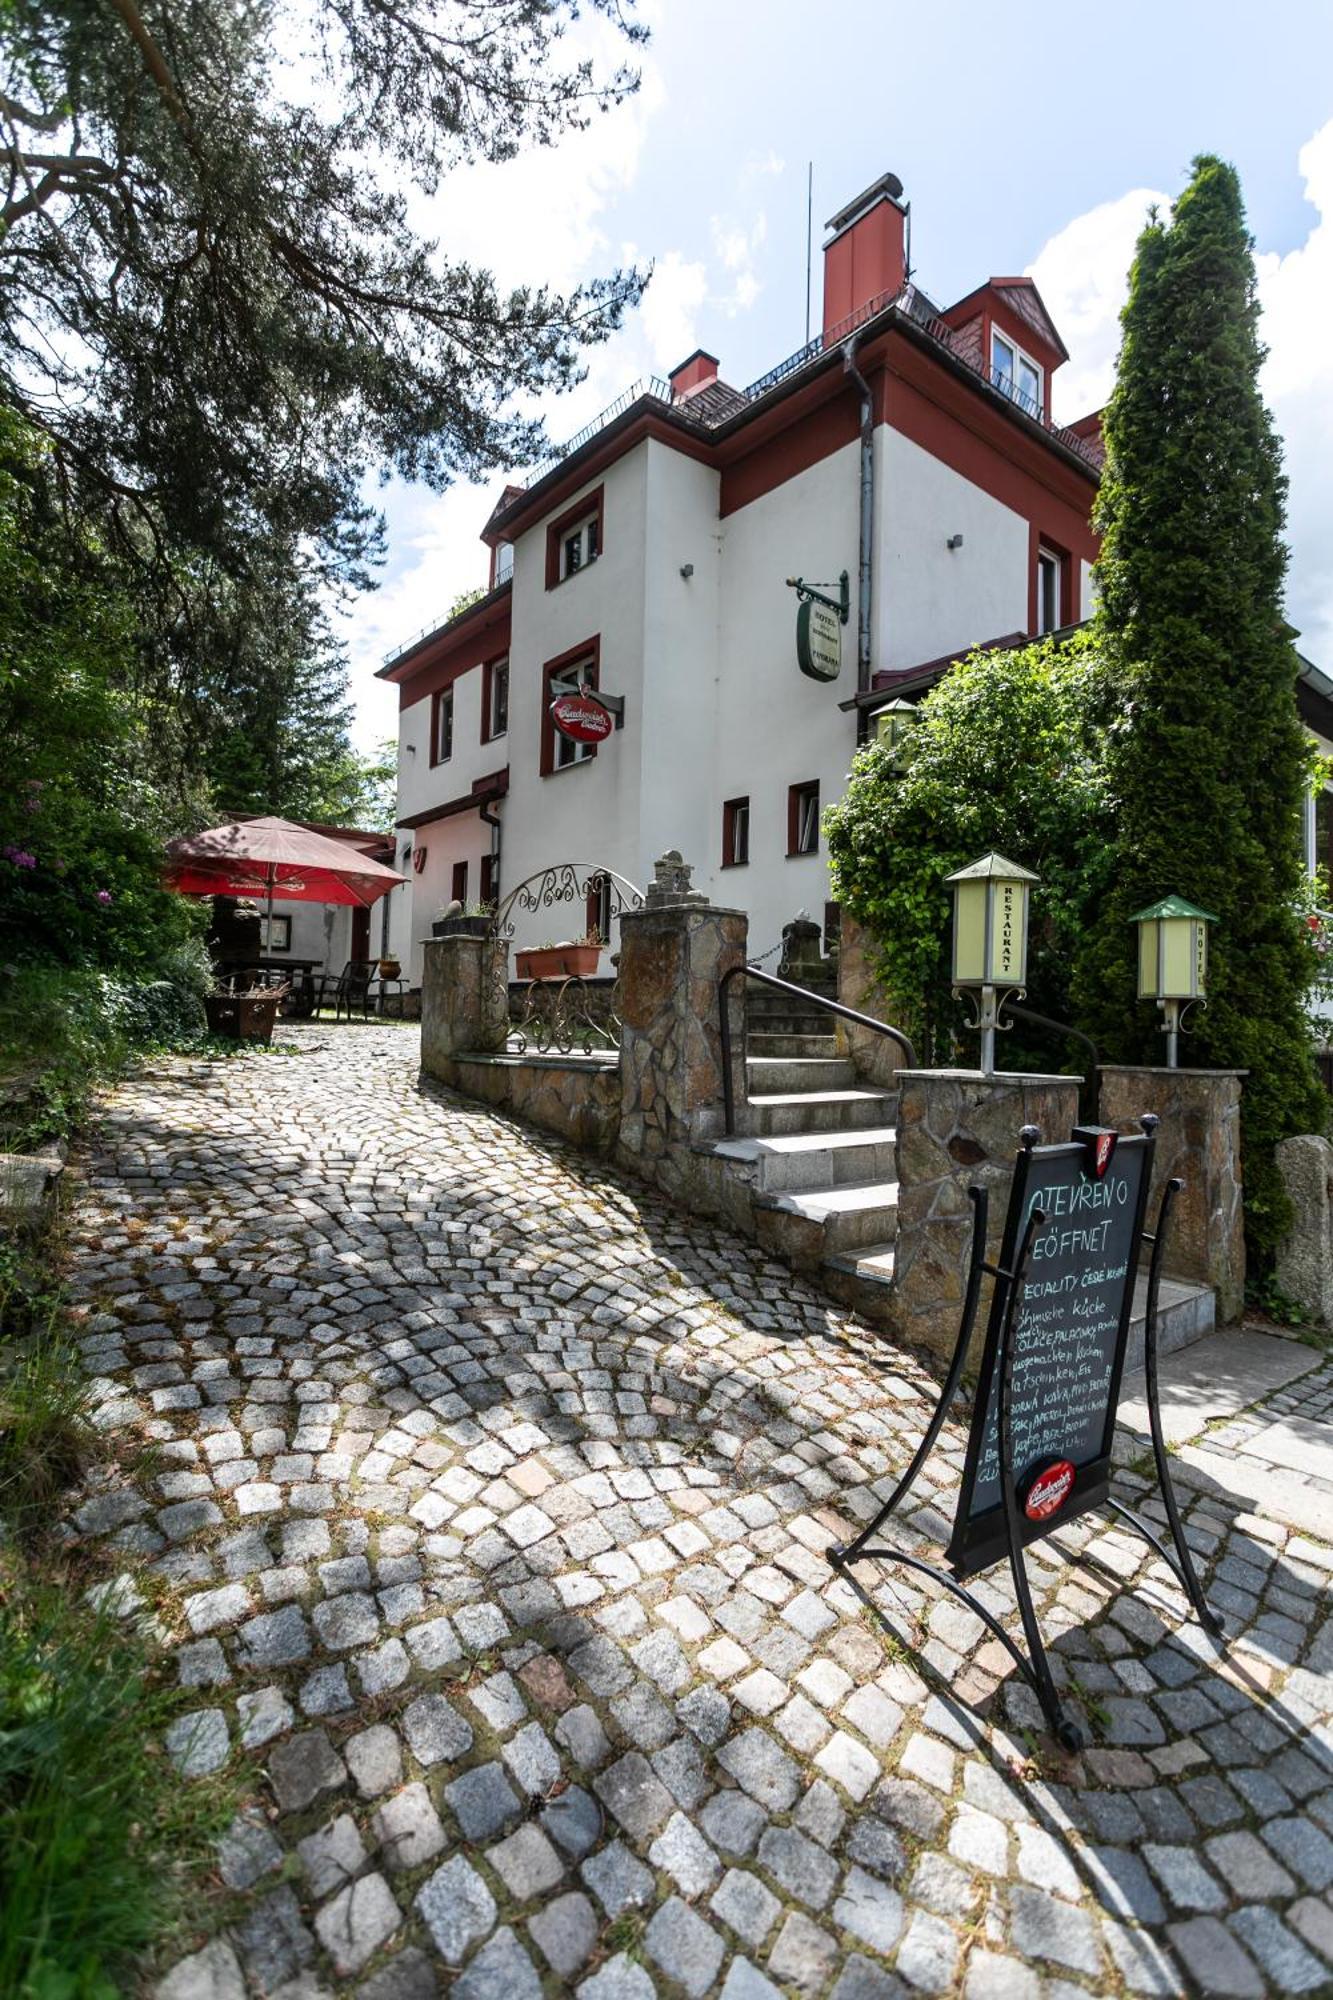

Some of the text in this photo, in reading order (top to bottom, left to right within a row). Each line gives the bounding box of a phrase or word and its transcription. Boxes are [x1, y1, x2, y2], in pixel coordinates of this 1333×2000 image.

[815, 611, 837, 628] HOTEL
[1002, 887, 1012, 972] RESTAURANT
[1032, 1220, 1113, 1260] EÖFFNET
[1023, 1275, 1078, 1300] ECIALITY
